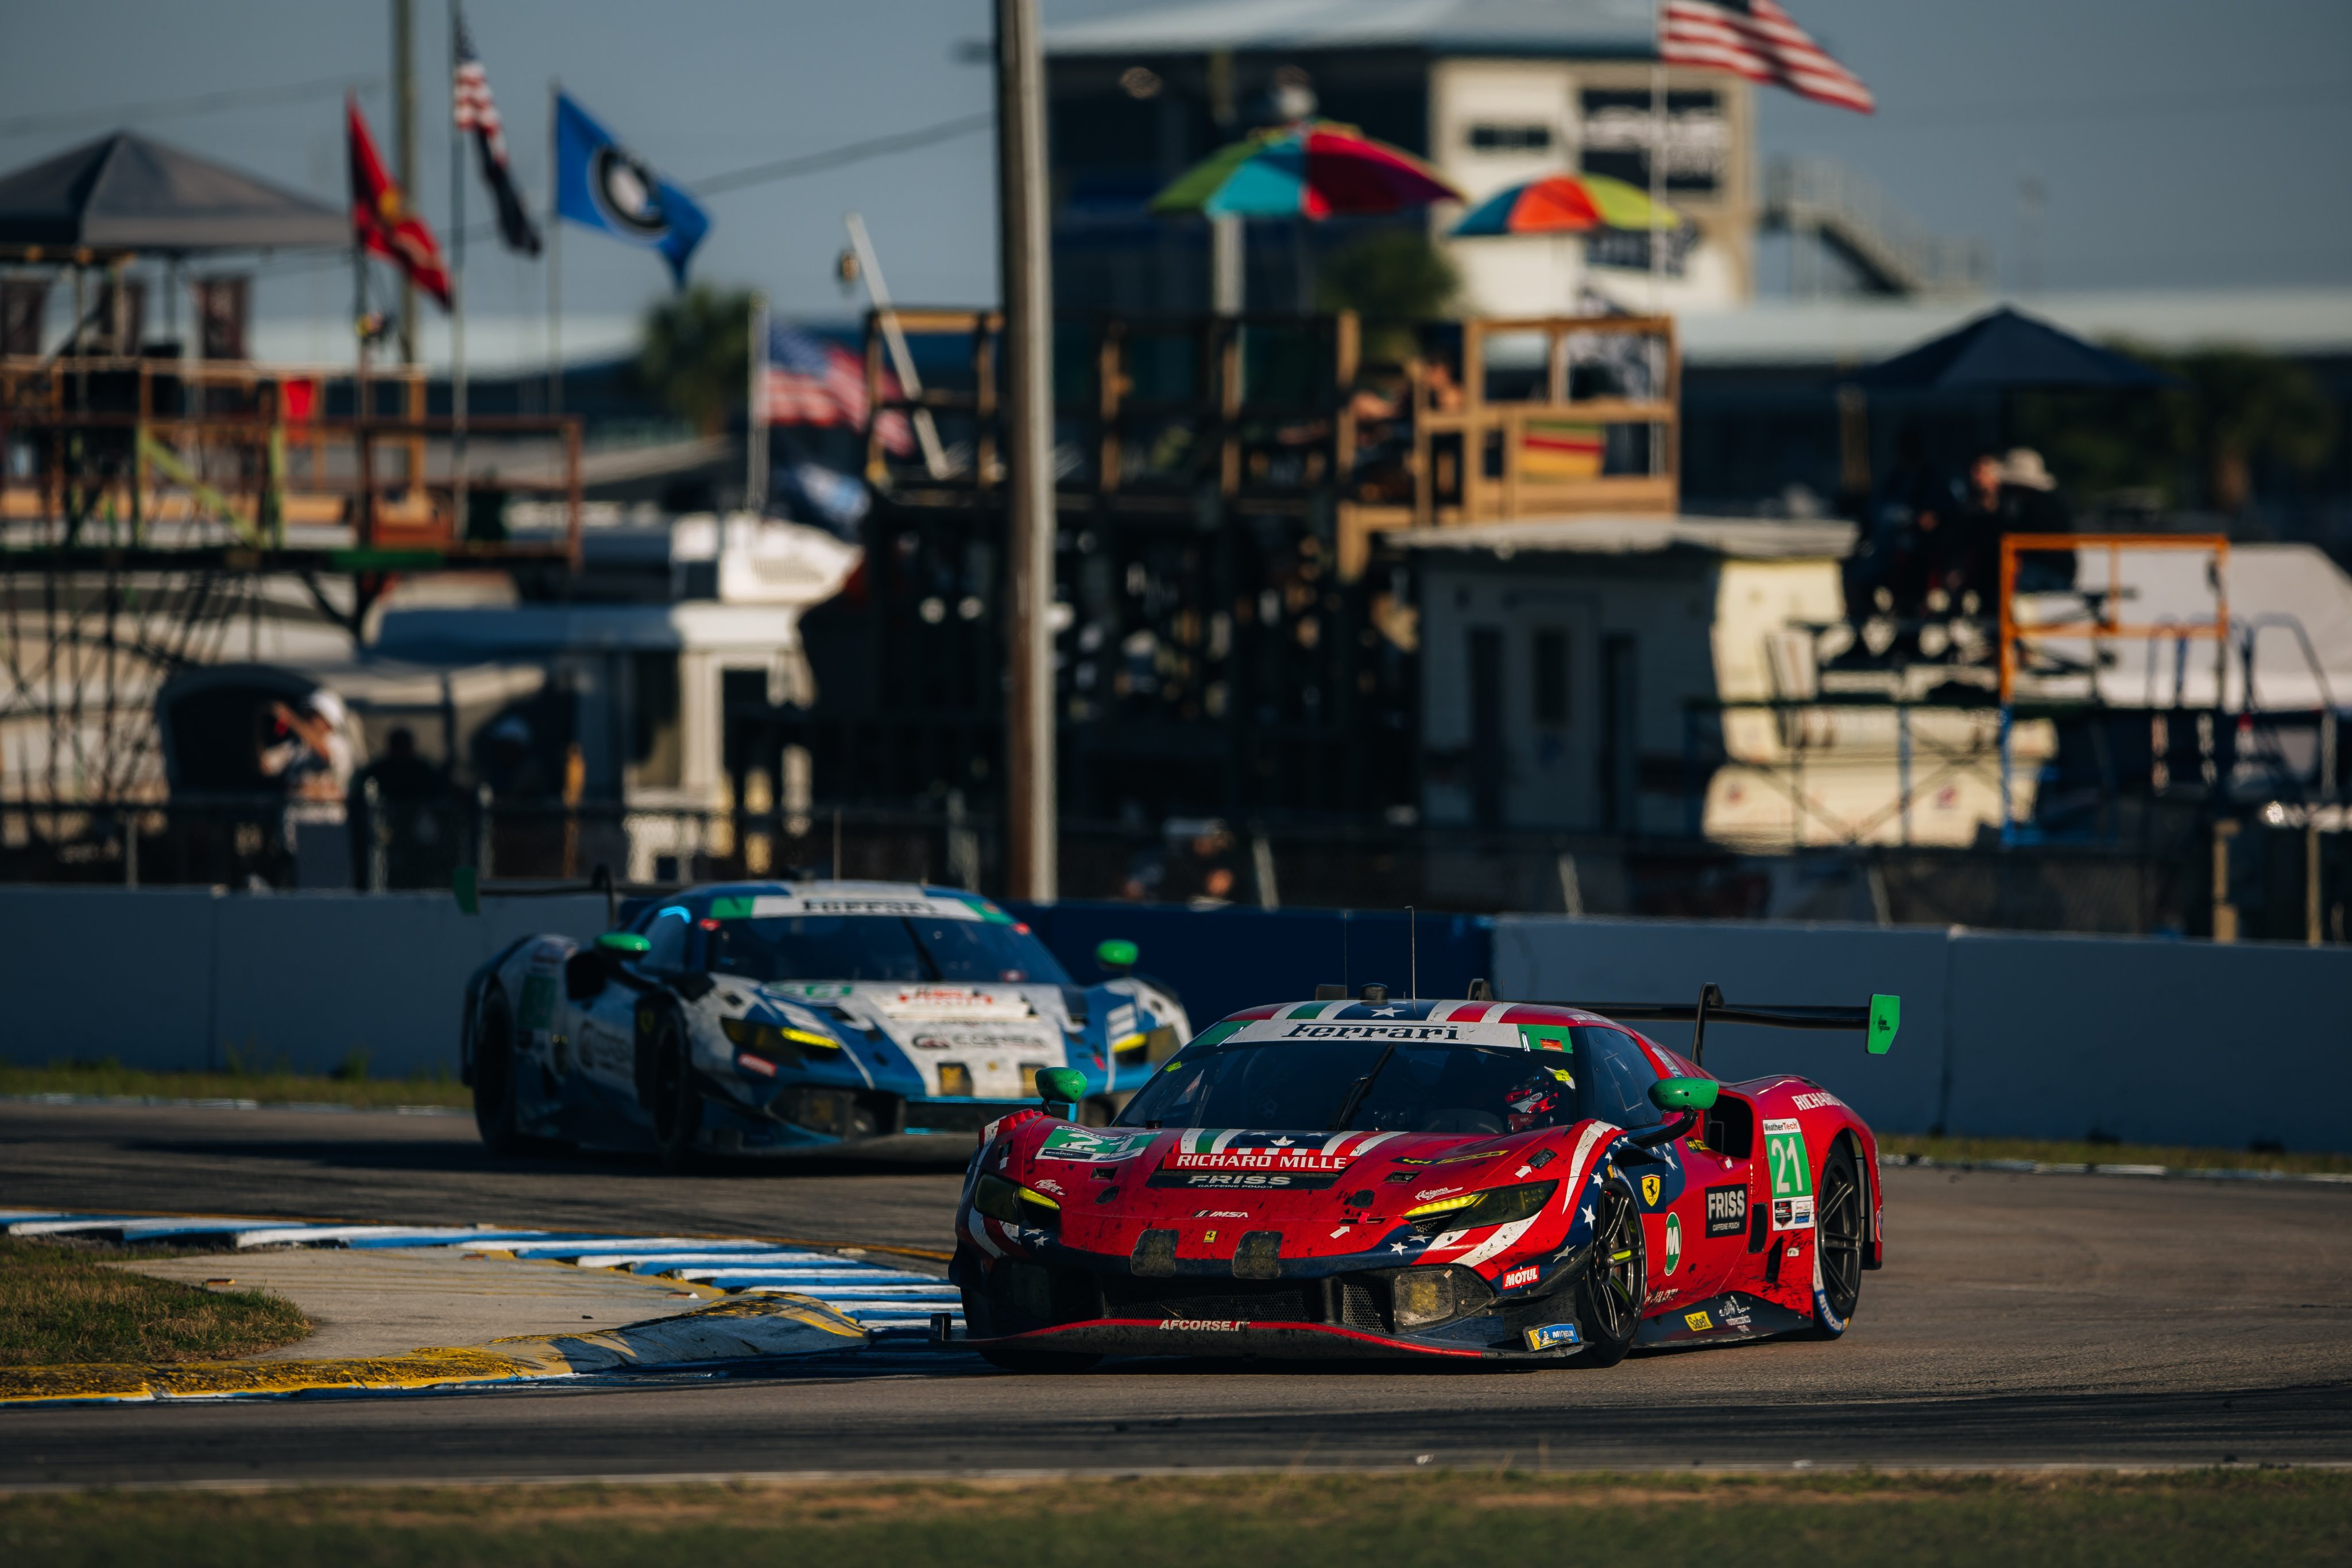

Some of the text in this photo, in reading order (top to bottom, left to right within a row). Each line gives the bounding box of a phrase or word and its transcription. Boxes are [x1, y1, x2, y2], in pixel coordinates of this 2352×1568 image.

[1282, 1023, 1459, 1040] Ferrari
[1764, 1121, 1798, 1132] WeatherTech
[1058, 1133, 1136, 1152] 21
[1177, 1155, 1347, 1169] RICHARD MILLE
[1771, 1137, 1803, 1194] 21
[1187, 1175, 1291, 1185] FRISS
[1708, 1190, 1745, 1220] FRISS
[1209, 1210, 1249, 1218] IMSA
[1504, 1267, 1538, 1287] MOTUL
[1159, 1319, 1251, 1332] AFCORSE.IT
[1552, 1330, 1575, 1338] MICHELIN
